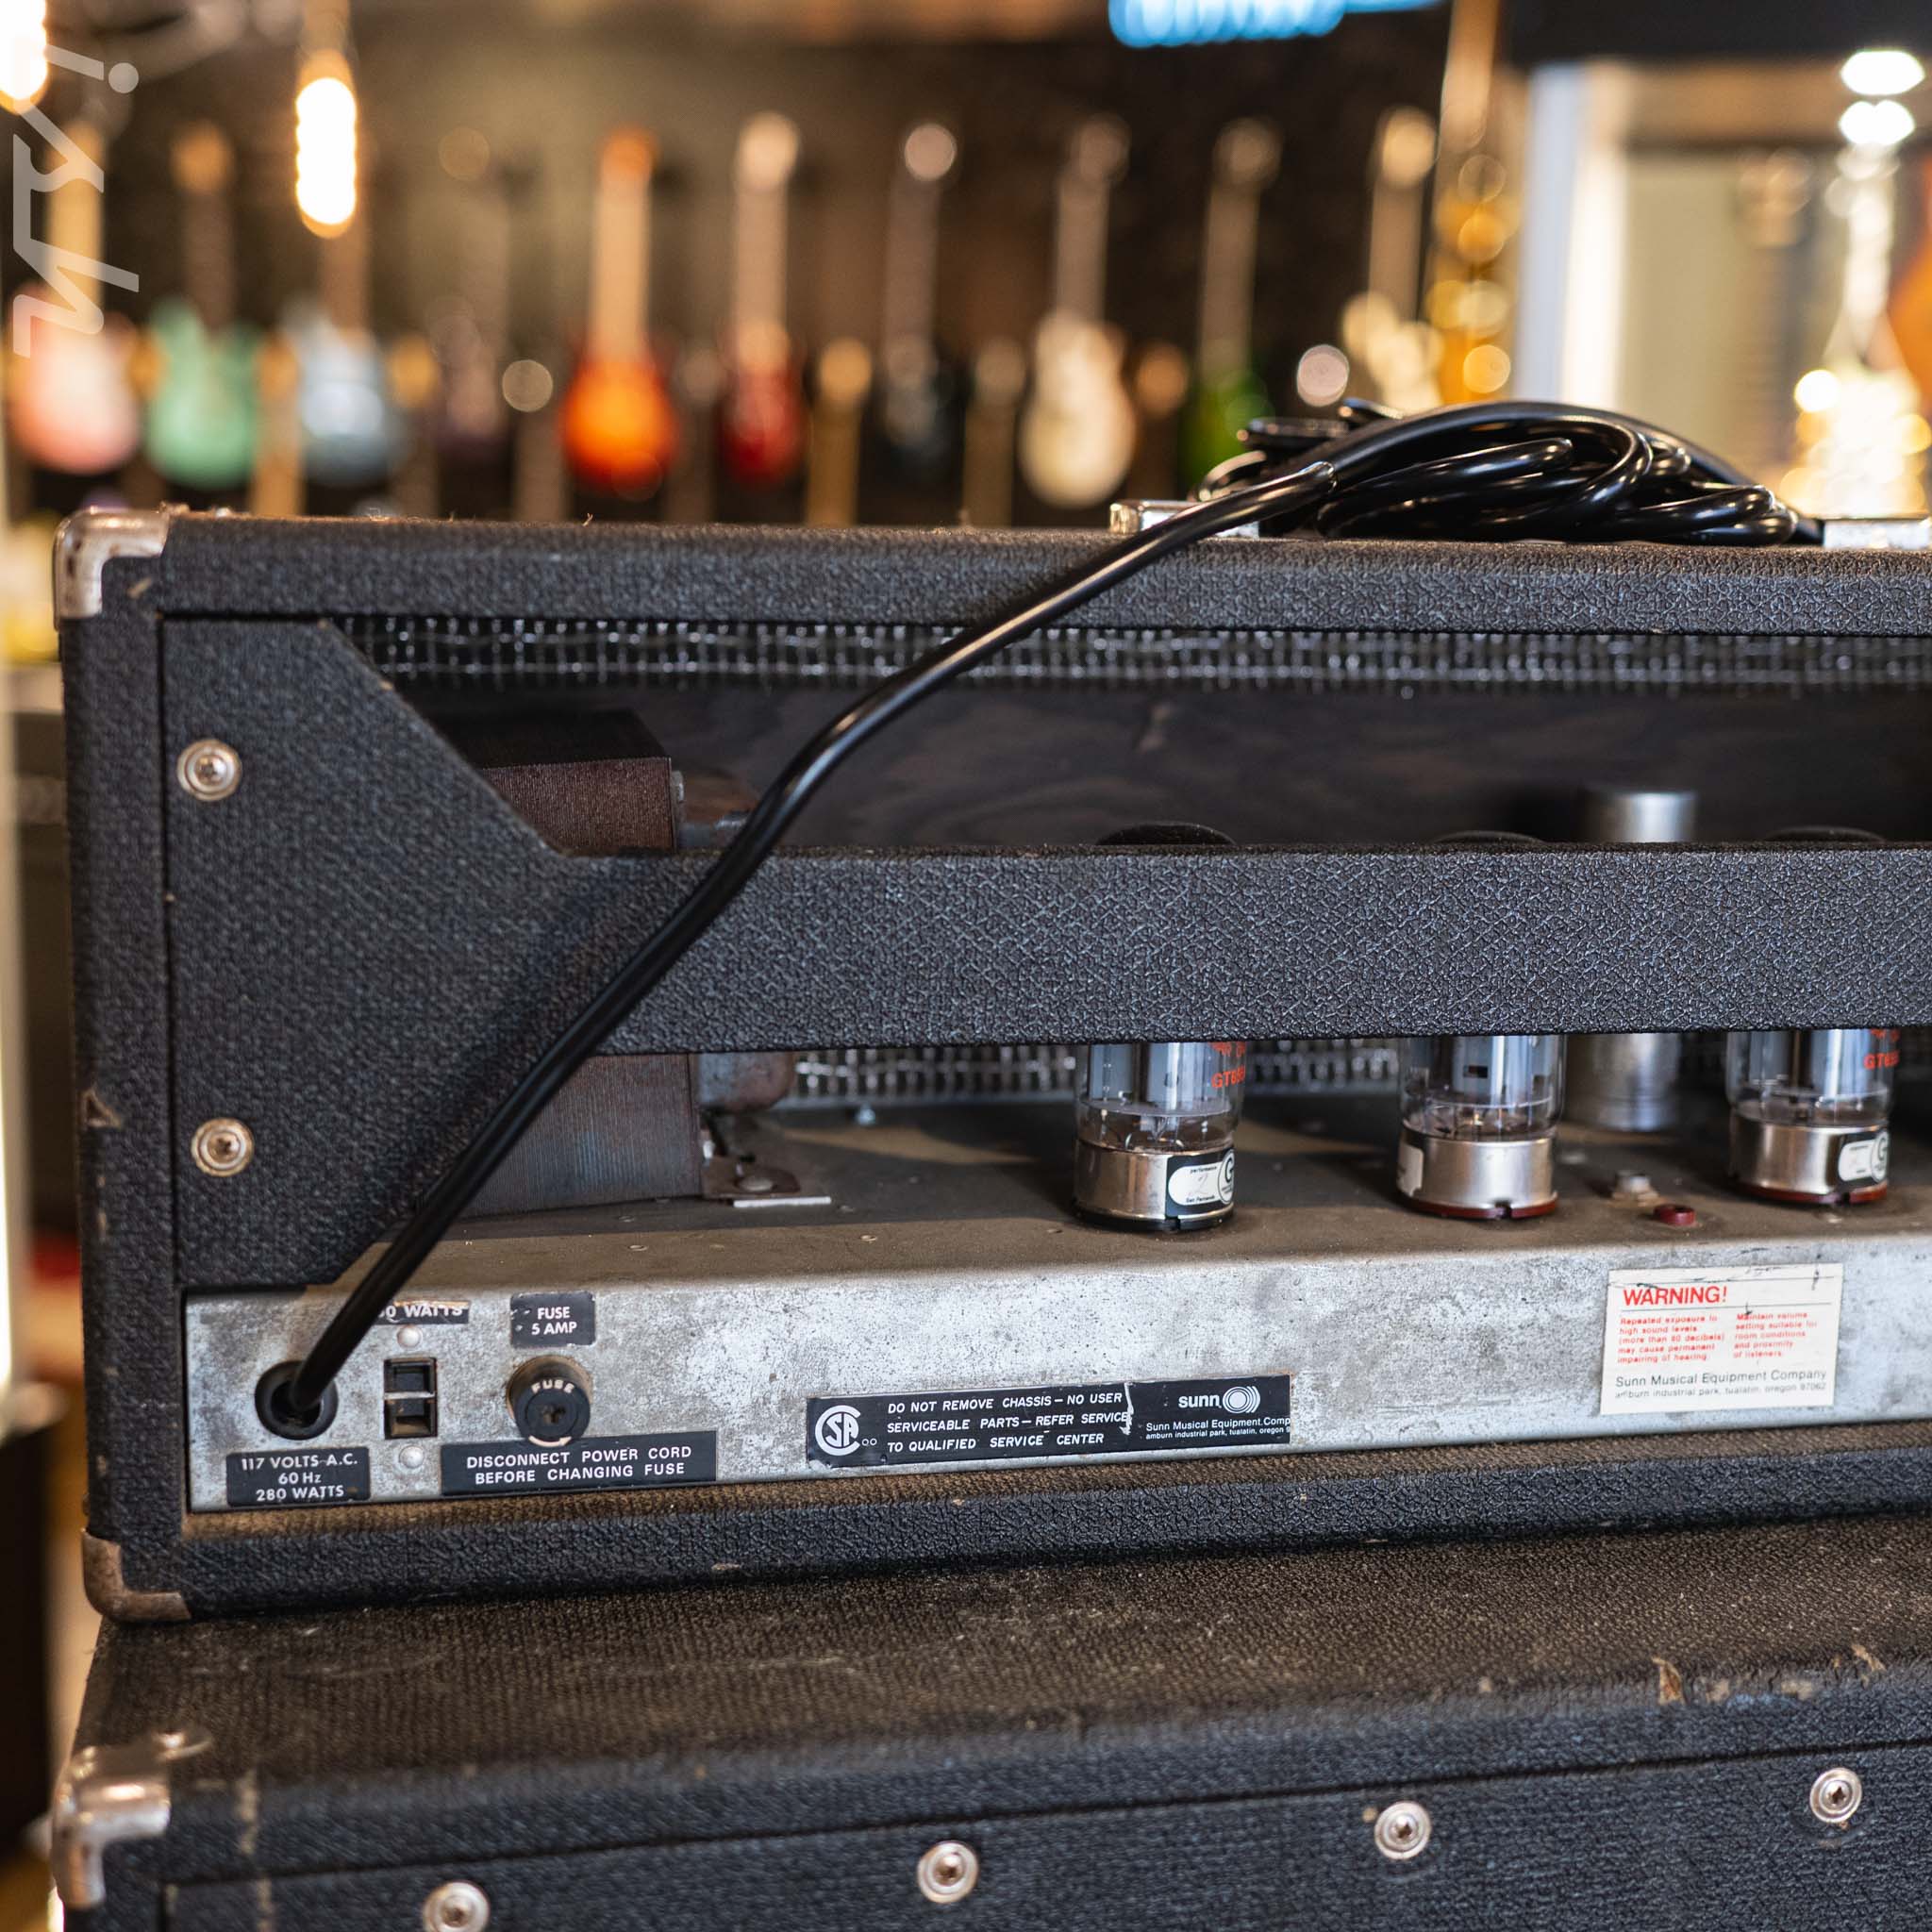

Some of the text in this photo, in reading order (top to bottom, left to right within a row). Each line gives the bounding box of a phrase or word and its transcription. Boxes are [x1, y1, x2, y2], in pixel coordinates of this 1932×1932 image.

[1623, 1286, 1727, 1307] WARNING!
[378, 1305, 463, 1318] 0 WATTS
[537, 1307, 570, 1320] FUSE
[531, 1321, 577, 1336] 5 AMP
[530, 1379, 575, 1393] FUSE
[1615, 1370, 1826, 1388] Sunn Musical Equipment Company
[888, 1403, 905, 1414] DO
[910, 1401, 937, 1413] NOT
[942, 1398, 993, 1411] REMOVE
[1003, 1396, 1052, 1408] CHASSIS
[1067, 1394, 1084, 1406] NO
[1090, 1392, 1123, 1404] USER
[1178, 1393, 1220, 1407] sunn
[888, 1420, 970, 1433] SERVICEABLE
[980, 1417, 1020, 1429] PARTS
[1035, 1414, 1074, 1426] REFER
[1081, 1411, 1128, 1424] SERVICE
[1146, 1422, 1170, 1432] Sunn
[1173, 1420, 1208, 1430] Musical
[1212, 1418, 1262, 1429] Equipment
[1259, 1426, 1284, 1435] oregon
[888, 1433, 1104, 1453] TO QUALIFIED SERVICE CENTER
[242, 1453, 358, 1471] 117 VOLTS A.C.
[467, 1446, 691, 1469] DISCONNECT POWER CORD
[278, 1472, 322, 1485] 60 Hz
[475, 1463, 685, 1485] BEFORE CHANGING FUSE
[256, 1485, 344, 1502] 280 WATTS
